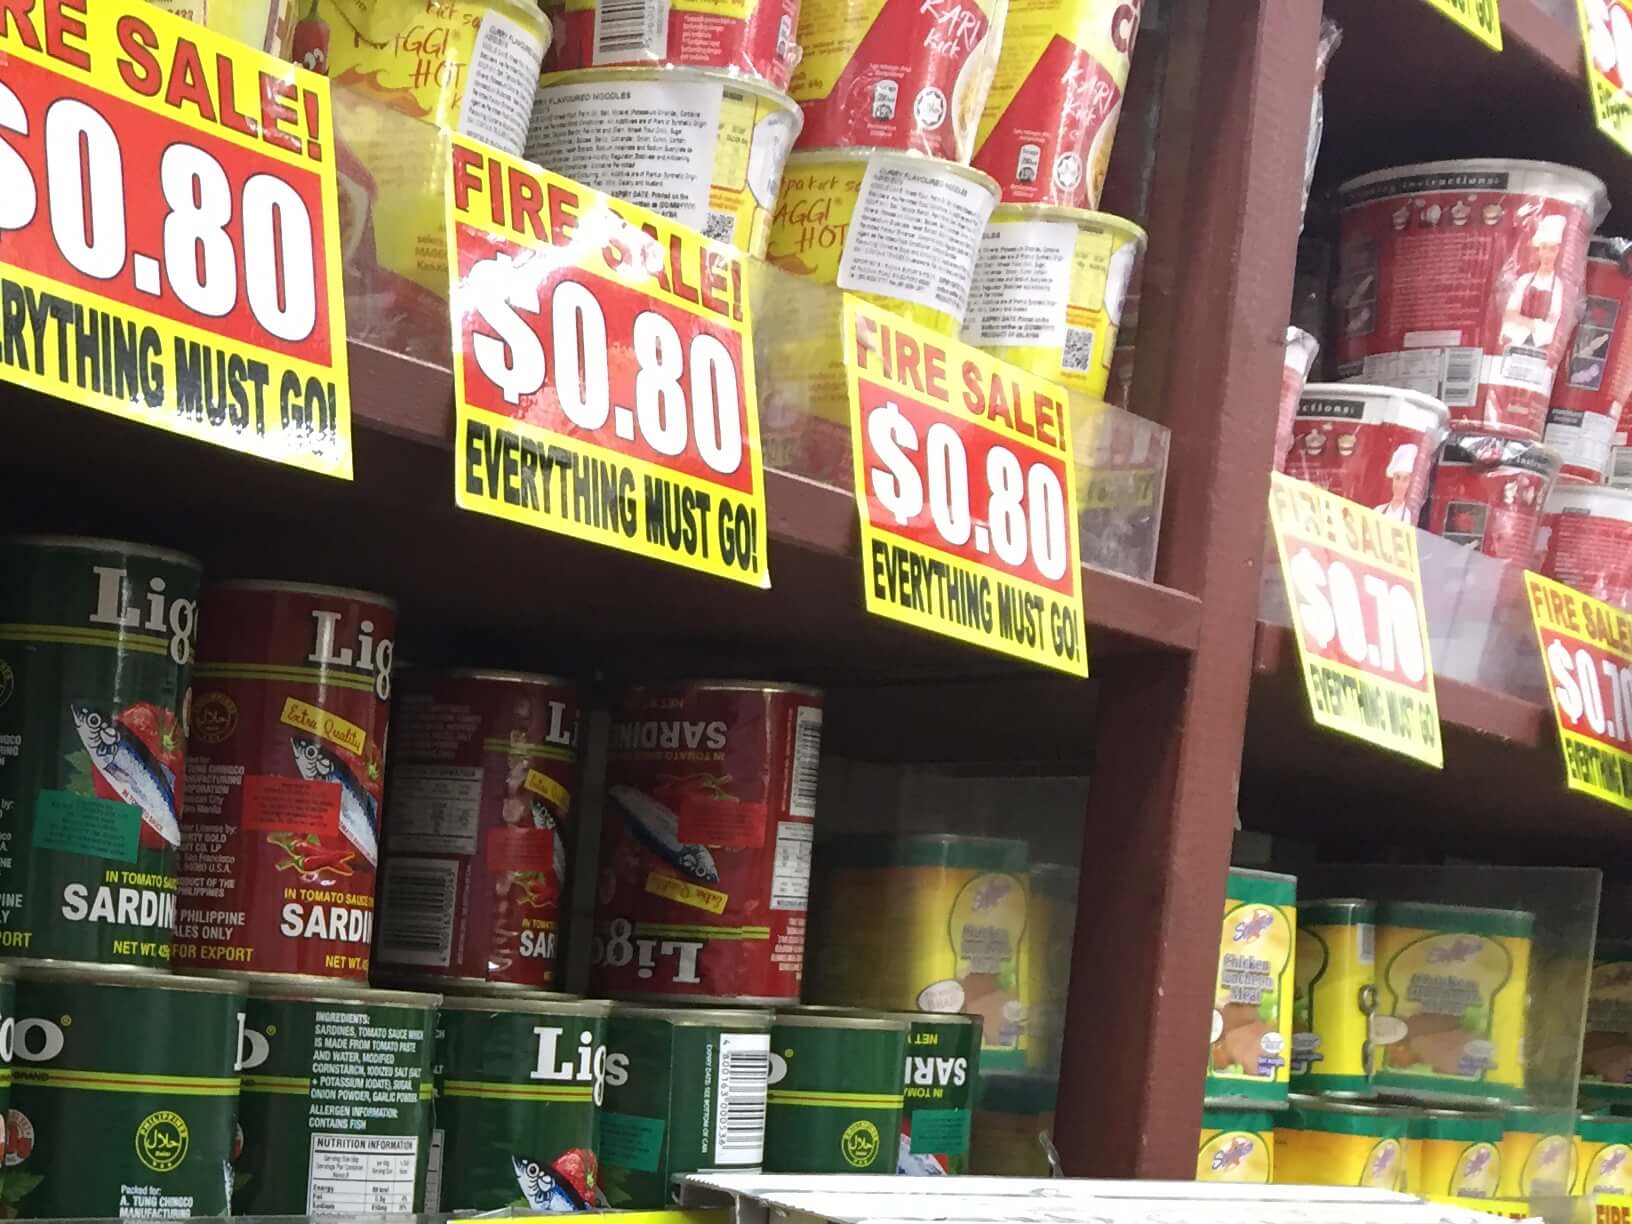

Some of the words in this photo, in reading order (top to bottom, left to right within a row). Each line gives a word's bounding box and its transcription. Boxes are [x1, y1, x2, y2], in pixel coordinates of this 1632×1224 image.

[116, 14, 324, 163] SALE!
[452, 142, 578, 247] FIRE
[174, 336, 270, 440] MUST
[280, 368, 339, 460] GO!
[470, 252, 742, 477] $0.80
[856, 312, 949, 403] FIRE
[961, 359, 1067, 452] SALE!
[466, 418, 637, 538] EVERYTHING
[645, 476, 712, 556] MUST
[717, 505, 760, 574] GO!
[868, 400, 1067, 583] $0.80
[1342, 506, 1415, 574] SALE!
[871, 537, 993, 636] EVERYTHING
[998, 587, 1045, 655] MUST
[1050, 603, 1081, 665] GO!
[1289, 547, 1426, 684] $0.70
[1530, 582, 1577, 631] FIRE
[179, 910, 246, 927] PHILIPPINE
[199, 925, 234, 941] ONLY
[200, 945, 255, 963] EXPORT
[299, 888, 343, 905] TOMATO
